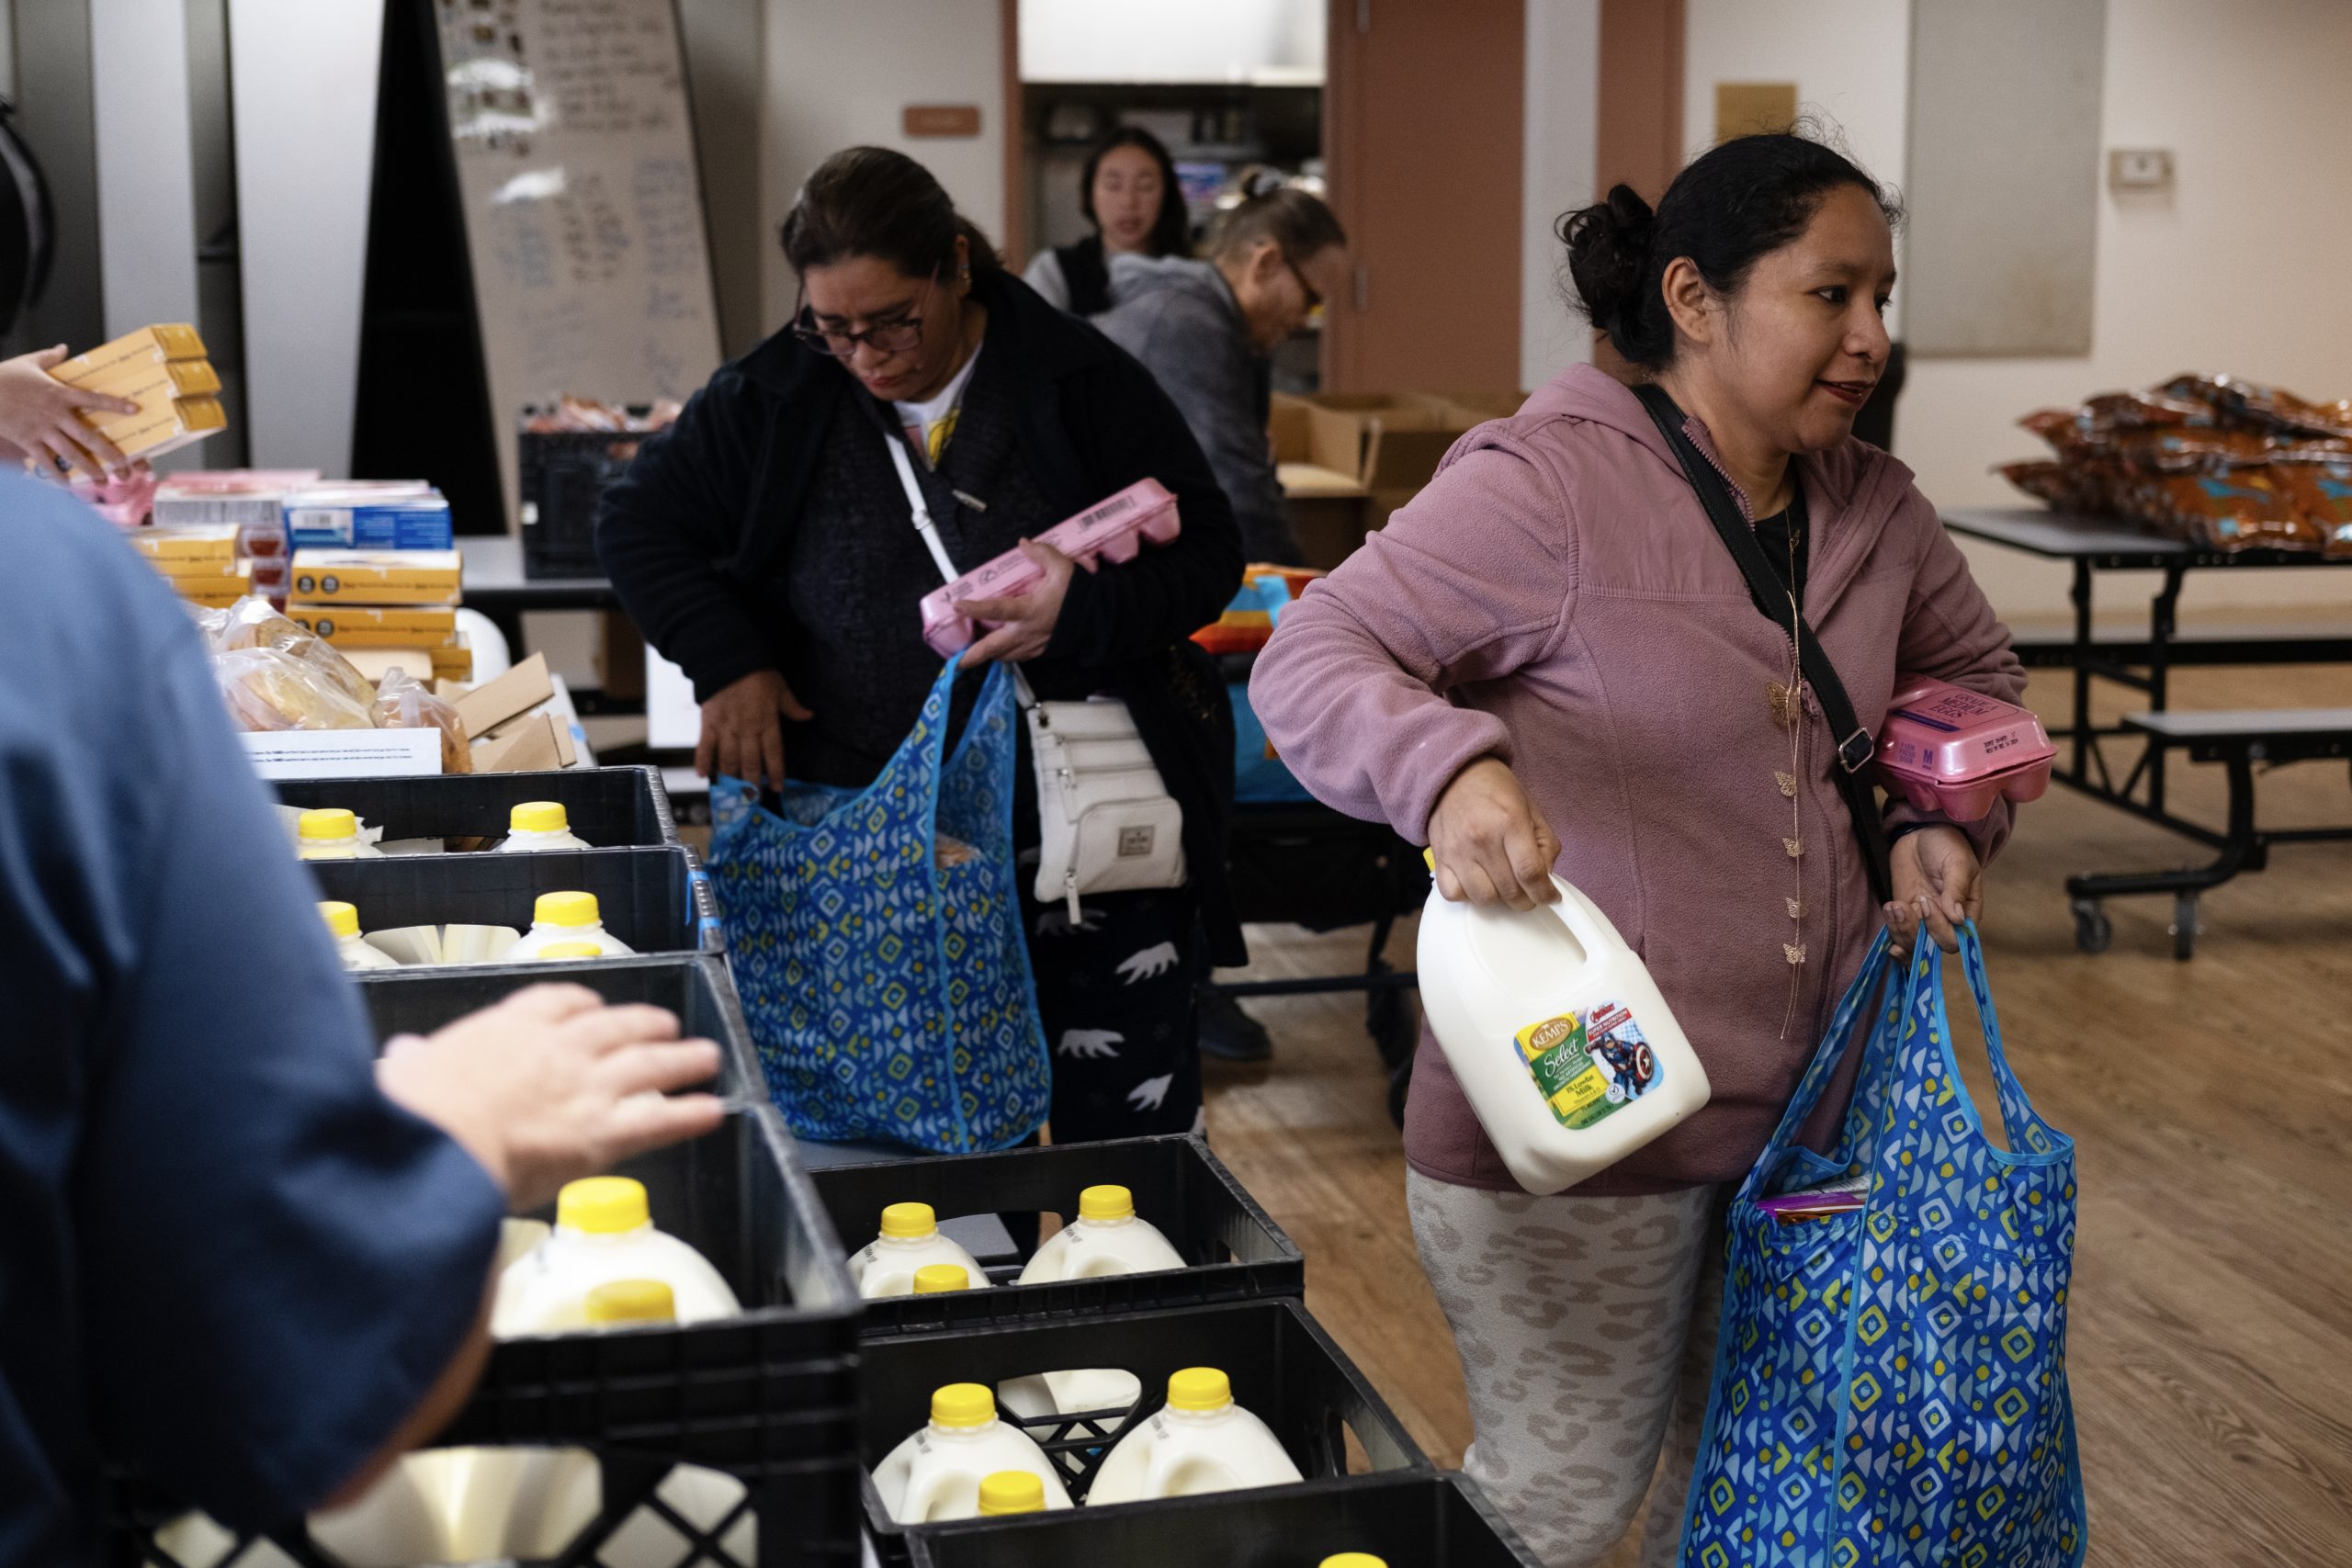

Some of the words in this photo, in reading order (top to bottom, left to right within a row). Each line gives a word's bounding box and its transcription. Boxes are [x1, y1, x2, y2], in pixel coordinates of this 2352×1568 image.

[1928, 705, 1962, 718] EGGS
[1940, 697, 1989, 716] MEDIUM
[1923, 749, 1933, 764] M
[1602, 1010, 1628, 1028] NUTRITION
[1532, 1021, 1569, 1047] KEMPS
[1588, 1022, 1604, 1036] SUPER
[1544, 1037, 1579, 1077] Select
[1573, 1074, 1594, 1089] Lowfat
[1575, 1083, 1594, 1098] Milk
